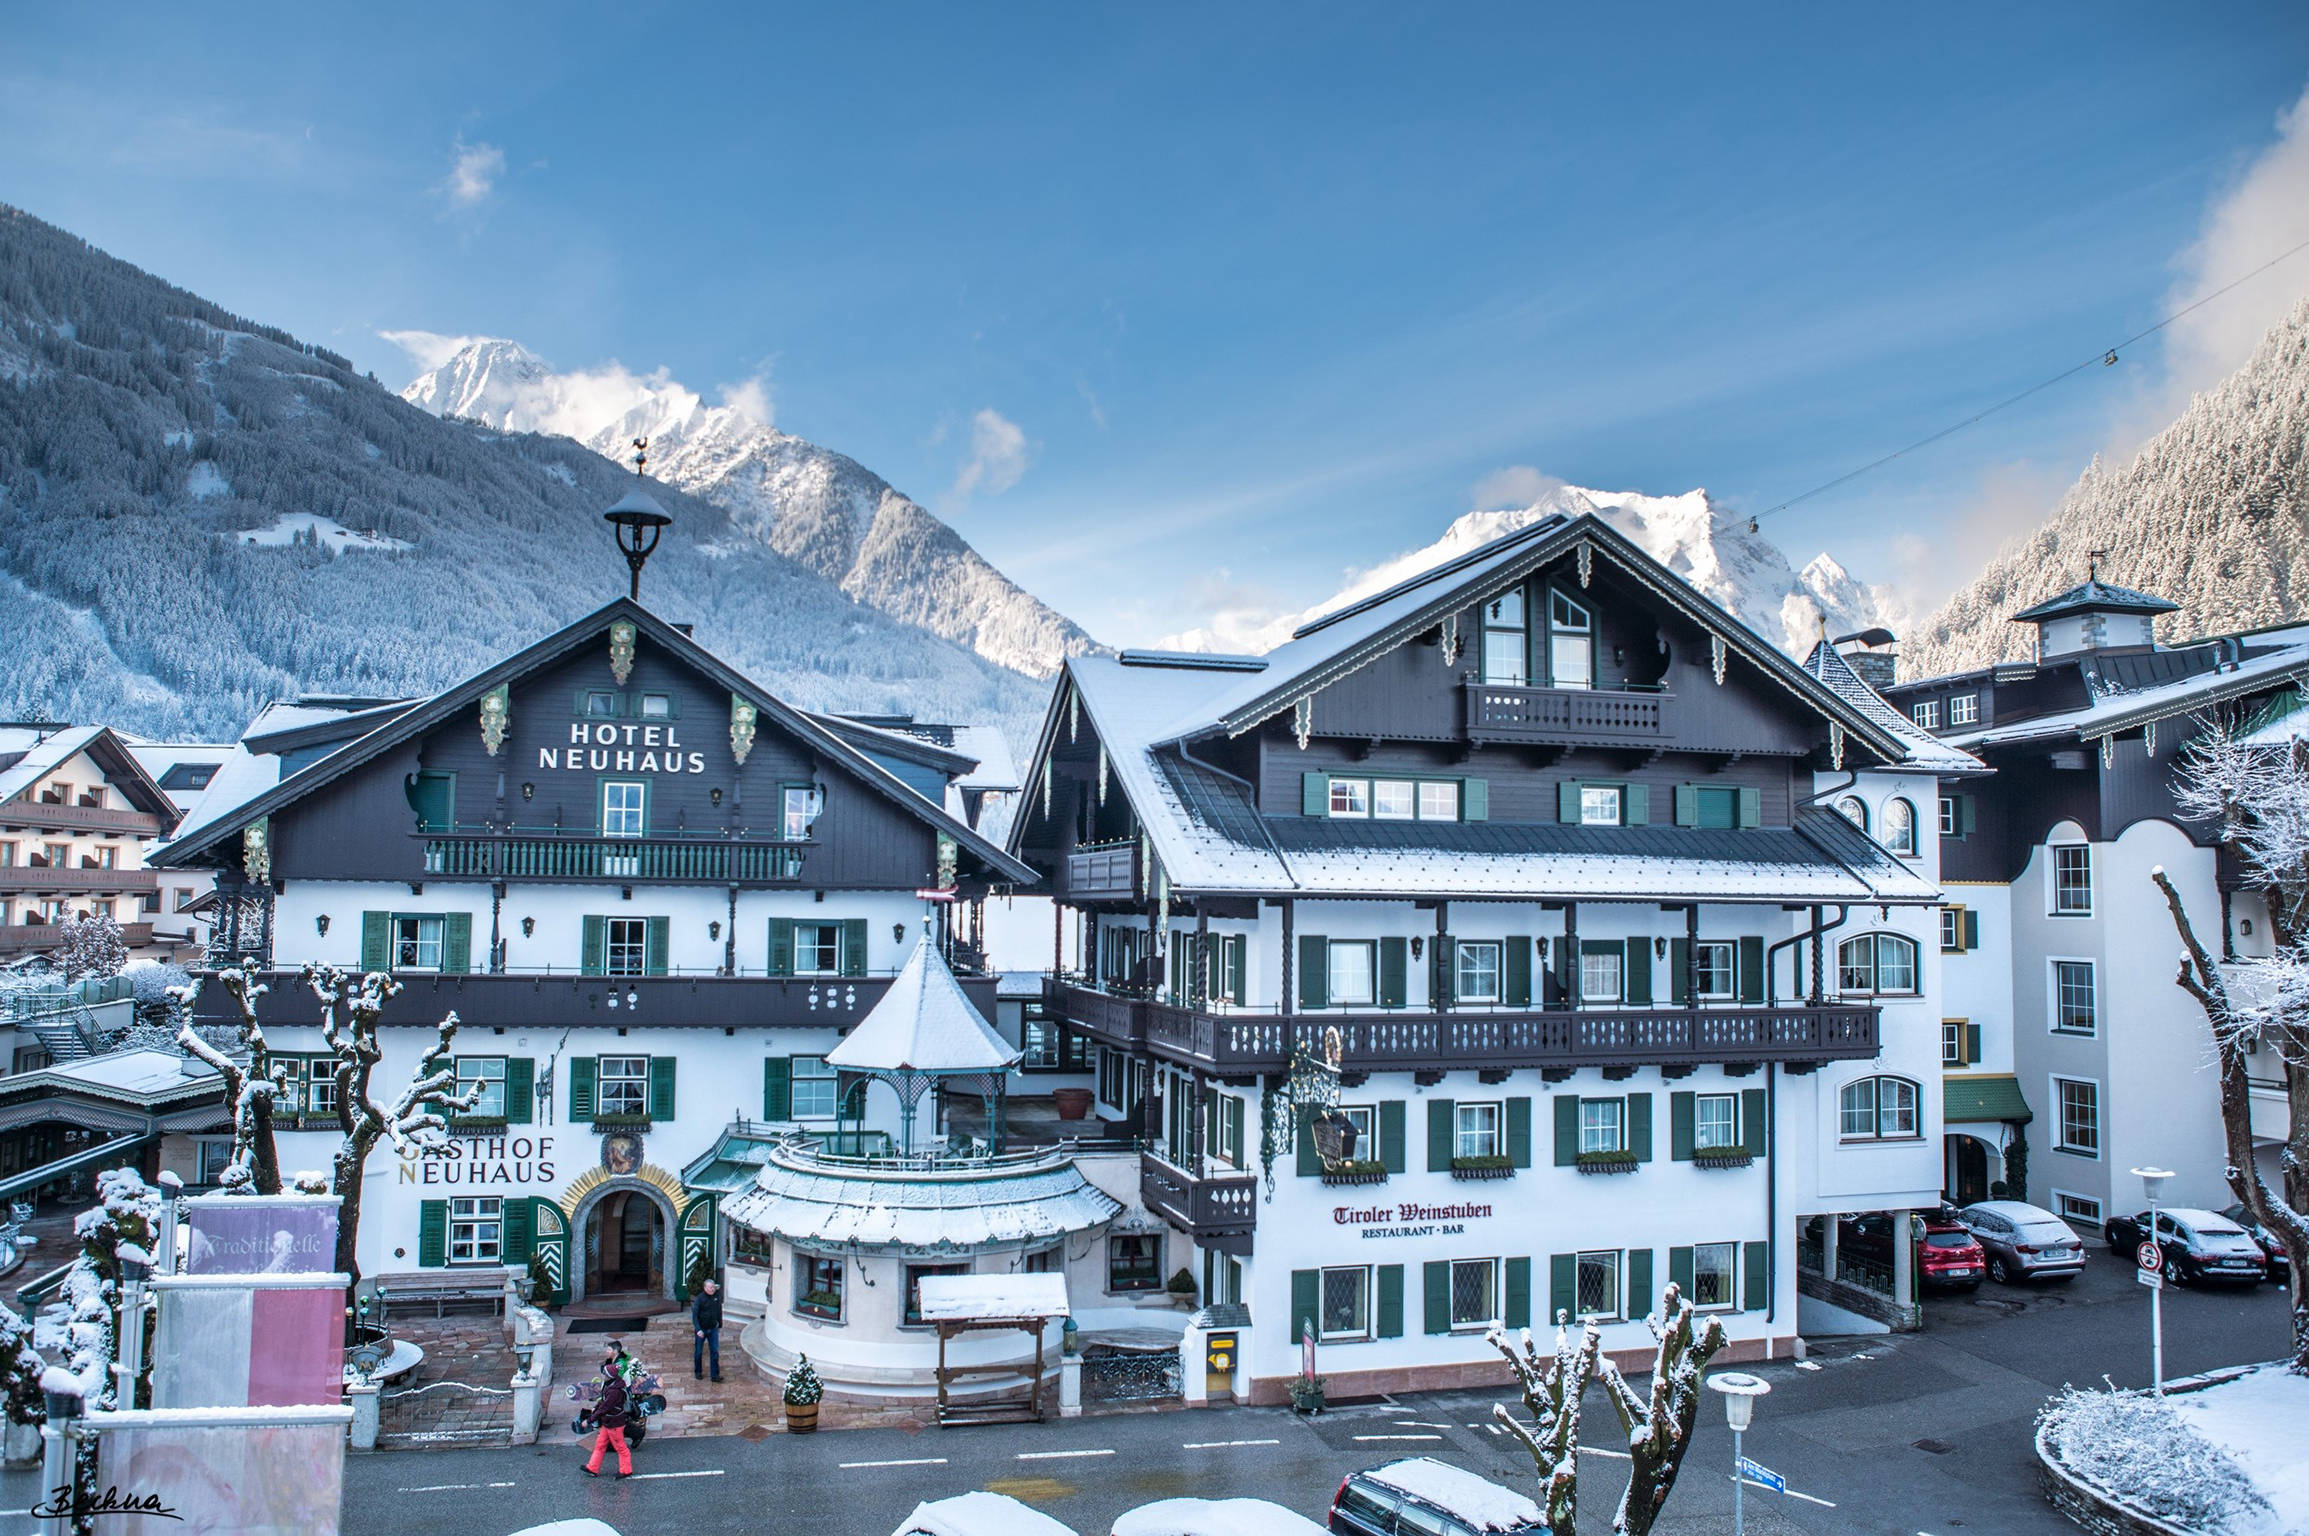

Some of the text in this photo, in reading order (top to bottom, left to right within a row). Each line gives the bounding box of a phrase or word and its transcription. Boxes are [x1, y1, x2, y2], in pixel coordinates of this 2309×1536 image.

[571, 723, 681, 747] HOTEL
[539, 748, 705, 773] NEUHAUS
[399, 1162, 555, 1184] NEUHAUS
[1333, 1202, 1492, 1225] Tiroler Weinstuben
[1362, 1225, 1465, 1239] RESTAURANT BAR
